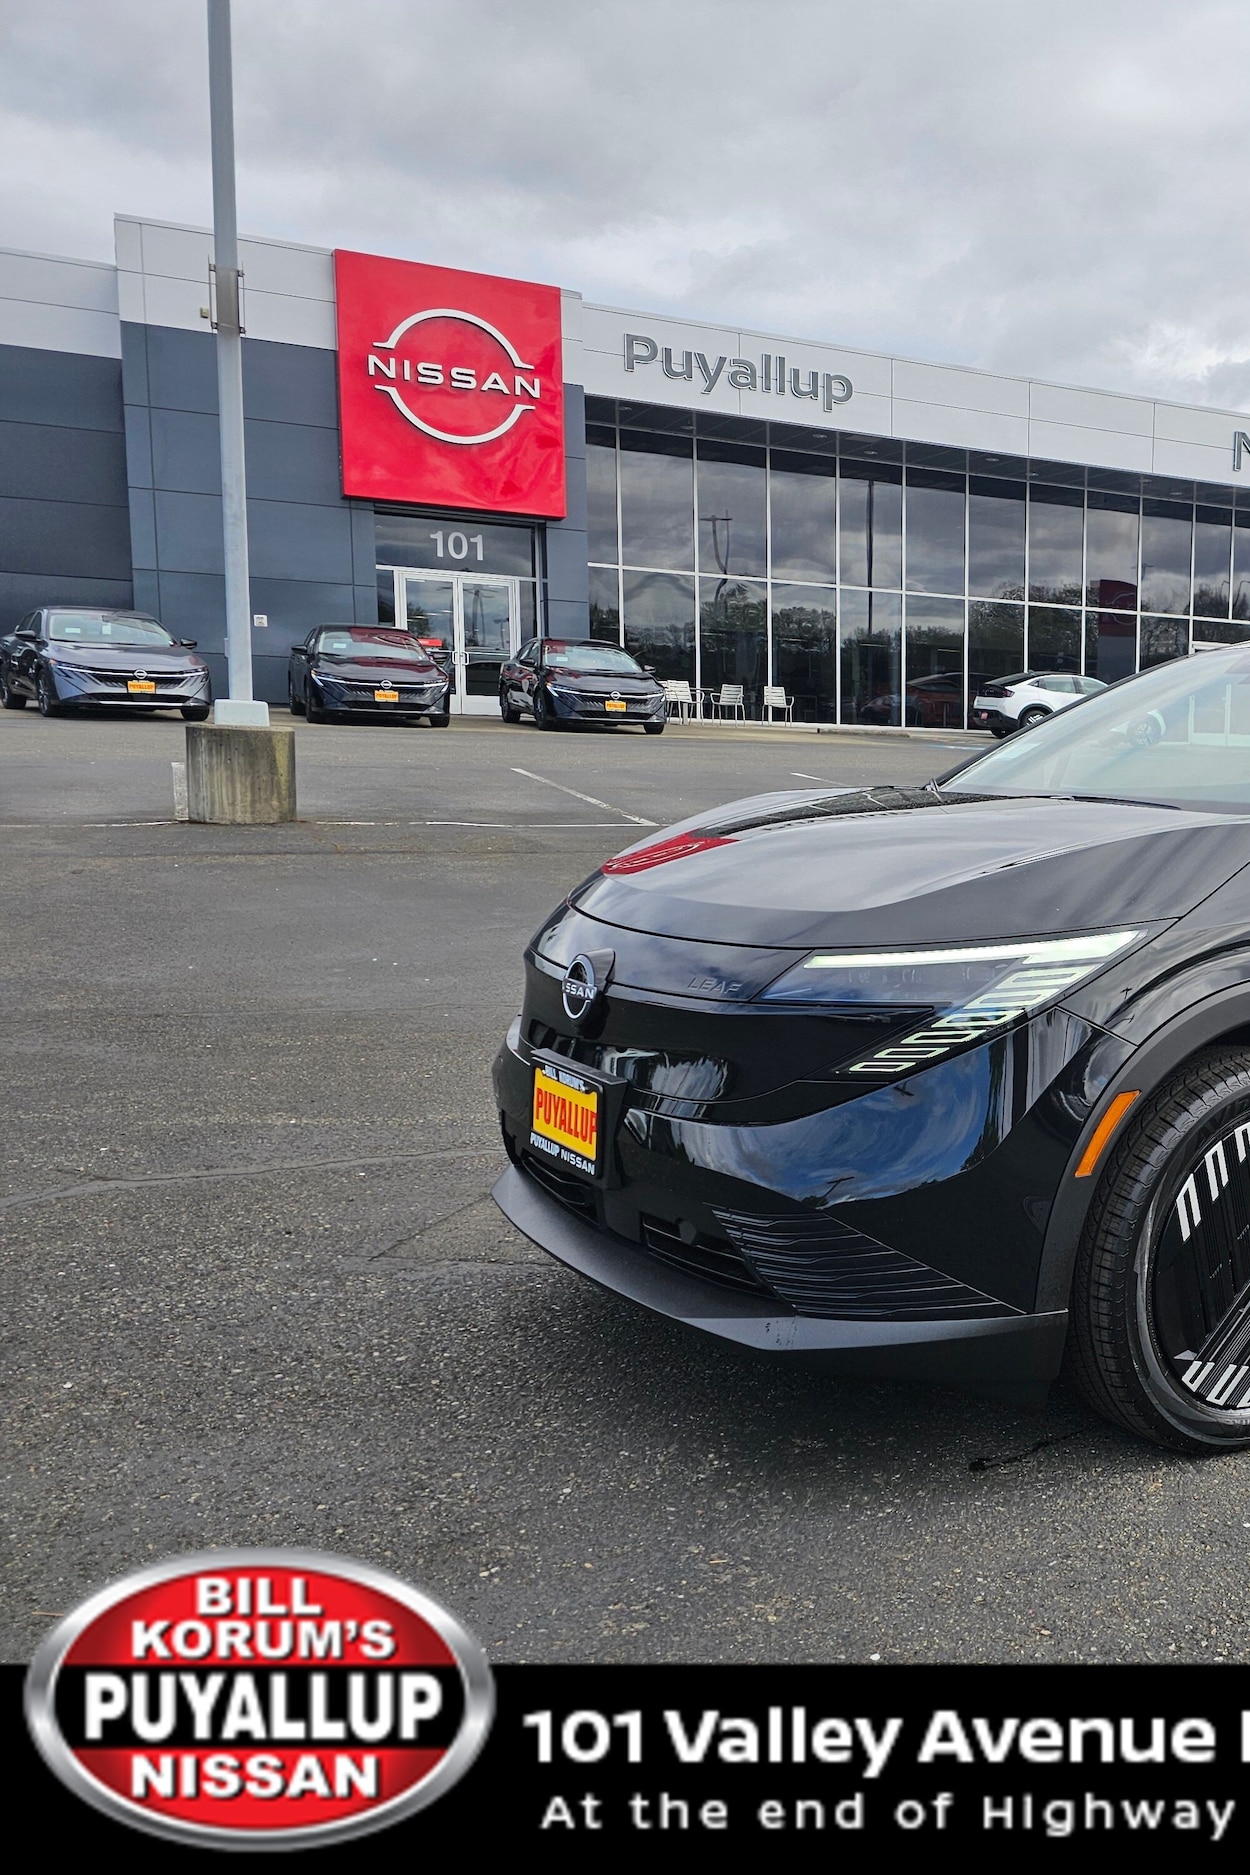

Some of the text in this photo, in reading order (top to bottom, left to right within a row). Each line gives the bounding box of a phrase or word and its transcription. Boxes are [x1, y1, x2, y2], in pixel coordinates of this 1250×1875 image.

[368, 354, 541, 399] NISSAN
[623, 333, 854, 413] Puyallup
[430, 531, 483, 561] 101
[687, 976, 743, 994] LEAF
[535, 1087, 598, 1145] PUYALLUP
[530, 1131, 595, 1176] PUYALLUP NISSAN
